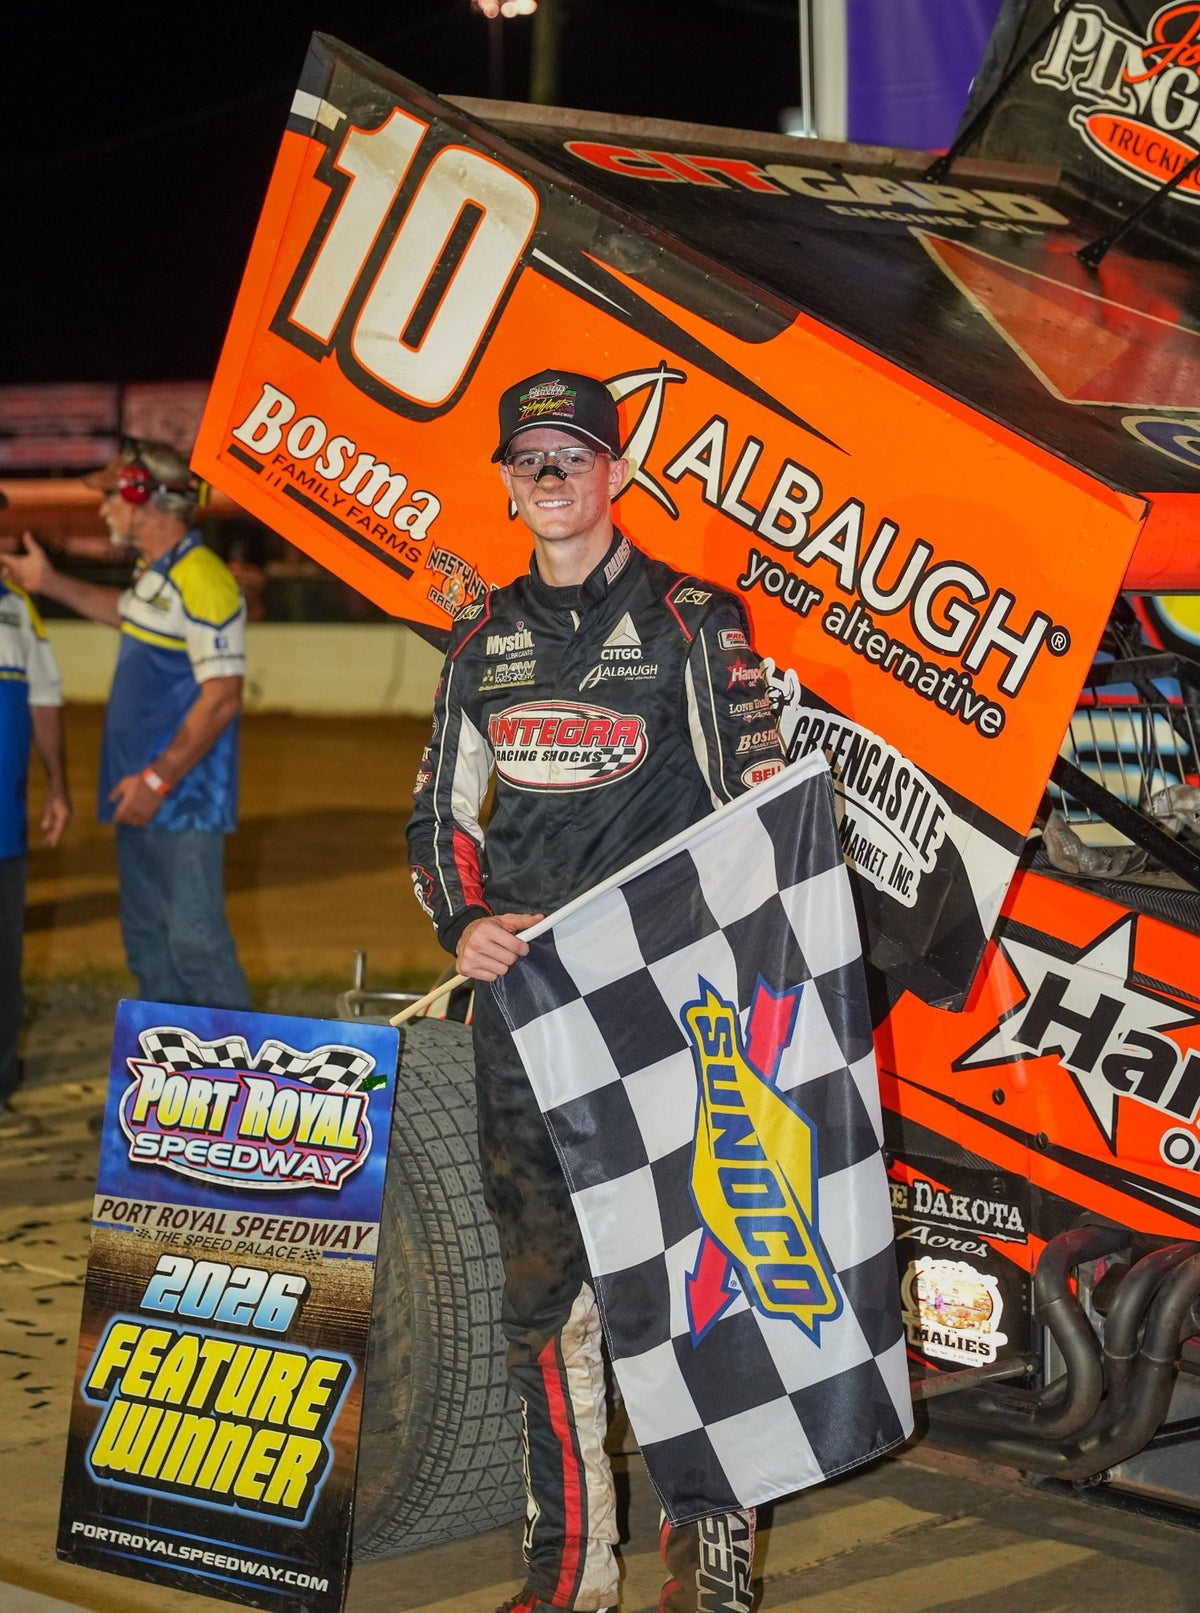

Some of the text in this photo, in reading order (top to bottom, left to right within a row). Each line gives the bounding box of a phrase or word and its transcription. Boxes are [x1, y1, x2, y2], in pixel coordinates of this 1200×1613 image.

[563, 141, 1071, 227] CITGARD
[287, 106, 540, 408] 10
[232, 382, 441, 541] Bosma
[272, 454, 422, 563] FAMILY FARMS
[428, 550, 471, 583] NASTY
[667, 418, 1048, 695] ALBAUGH
[486, 626, 534, 656] Mystik
[601, 648, 642, 660] CITGO
[602, 664, 658, 677] ALBAUGH
[740, 550, 1004, 735] your alternative
[490, 717, 641, 747] INTEGRA
[729, 701, 754, 714] LONE
[497, 750, 603, 763] RACING SHOCKS
[787, 716, 945, 863] GREENCASTLE
[130, 1062, 366, 1150] PORT ROYAL
[134, 1132, 353, 1182] SPEEDWAY
[694, 1016, 828, 1305] SUNOCO
[97, 1199, 374, 1250] PORT ROYAL SPEEDWAY
[896, 1226, 988, 1258] Acres
[914, 1181, 1025, 1232] DAKOTA
[152, 1230, 301, 1260] THE SPEED PALACE
[140, 1255, 308, 1333] 2026
[88, 1323, 343, 1431] FEATURE
[91, 1400, 322, 1509] WINNER
[71, 1521, 329, 1593] PORTROYALSPEEDWAY.COM
